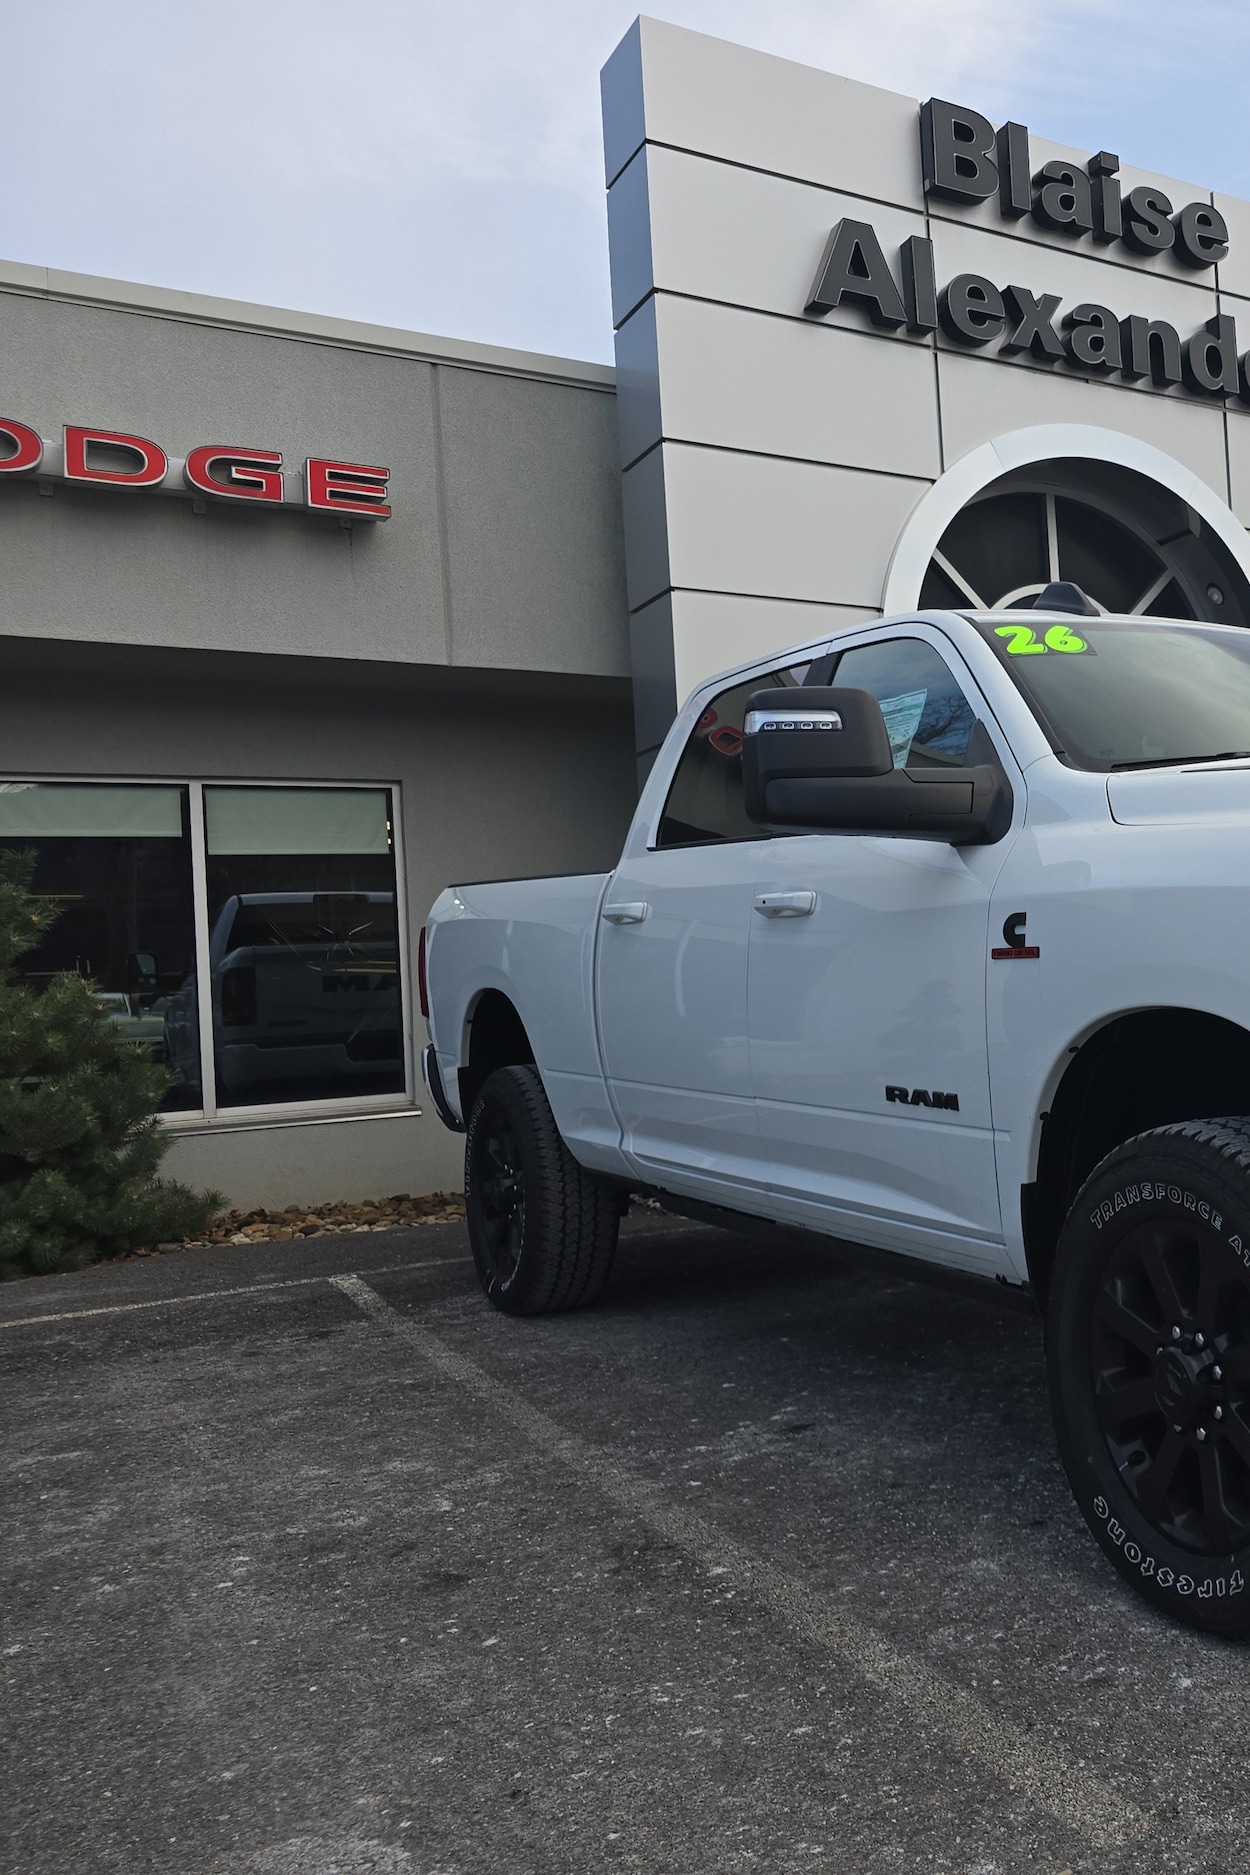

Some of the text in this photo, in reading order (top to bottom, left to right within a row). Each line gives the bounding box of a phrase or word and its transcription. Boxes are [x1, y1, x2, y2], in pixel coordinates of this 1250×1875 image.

[921, 97, 1229, 269] Blaise
[994, 625, 1088, 655] 26
[885, 1085, 960, 1111] RAM
[1089, 1182, 1225, 1231] TRANSFORCE
